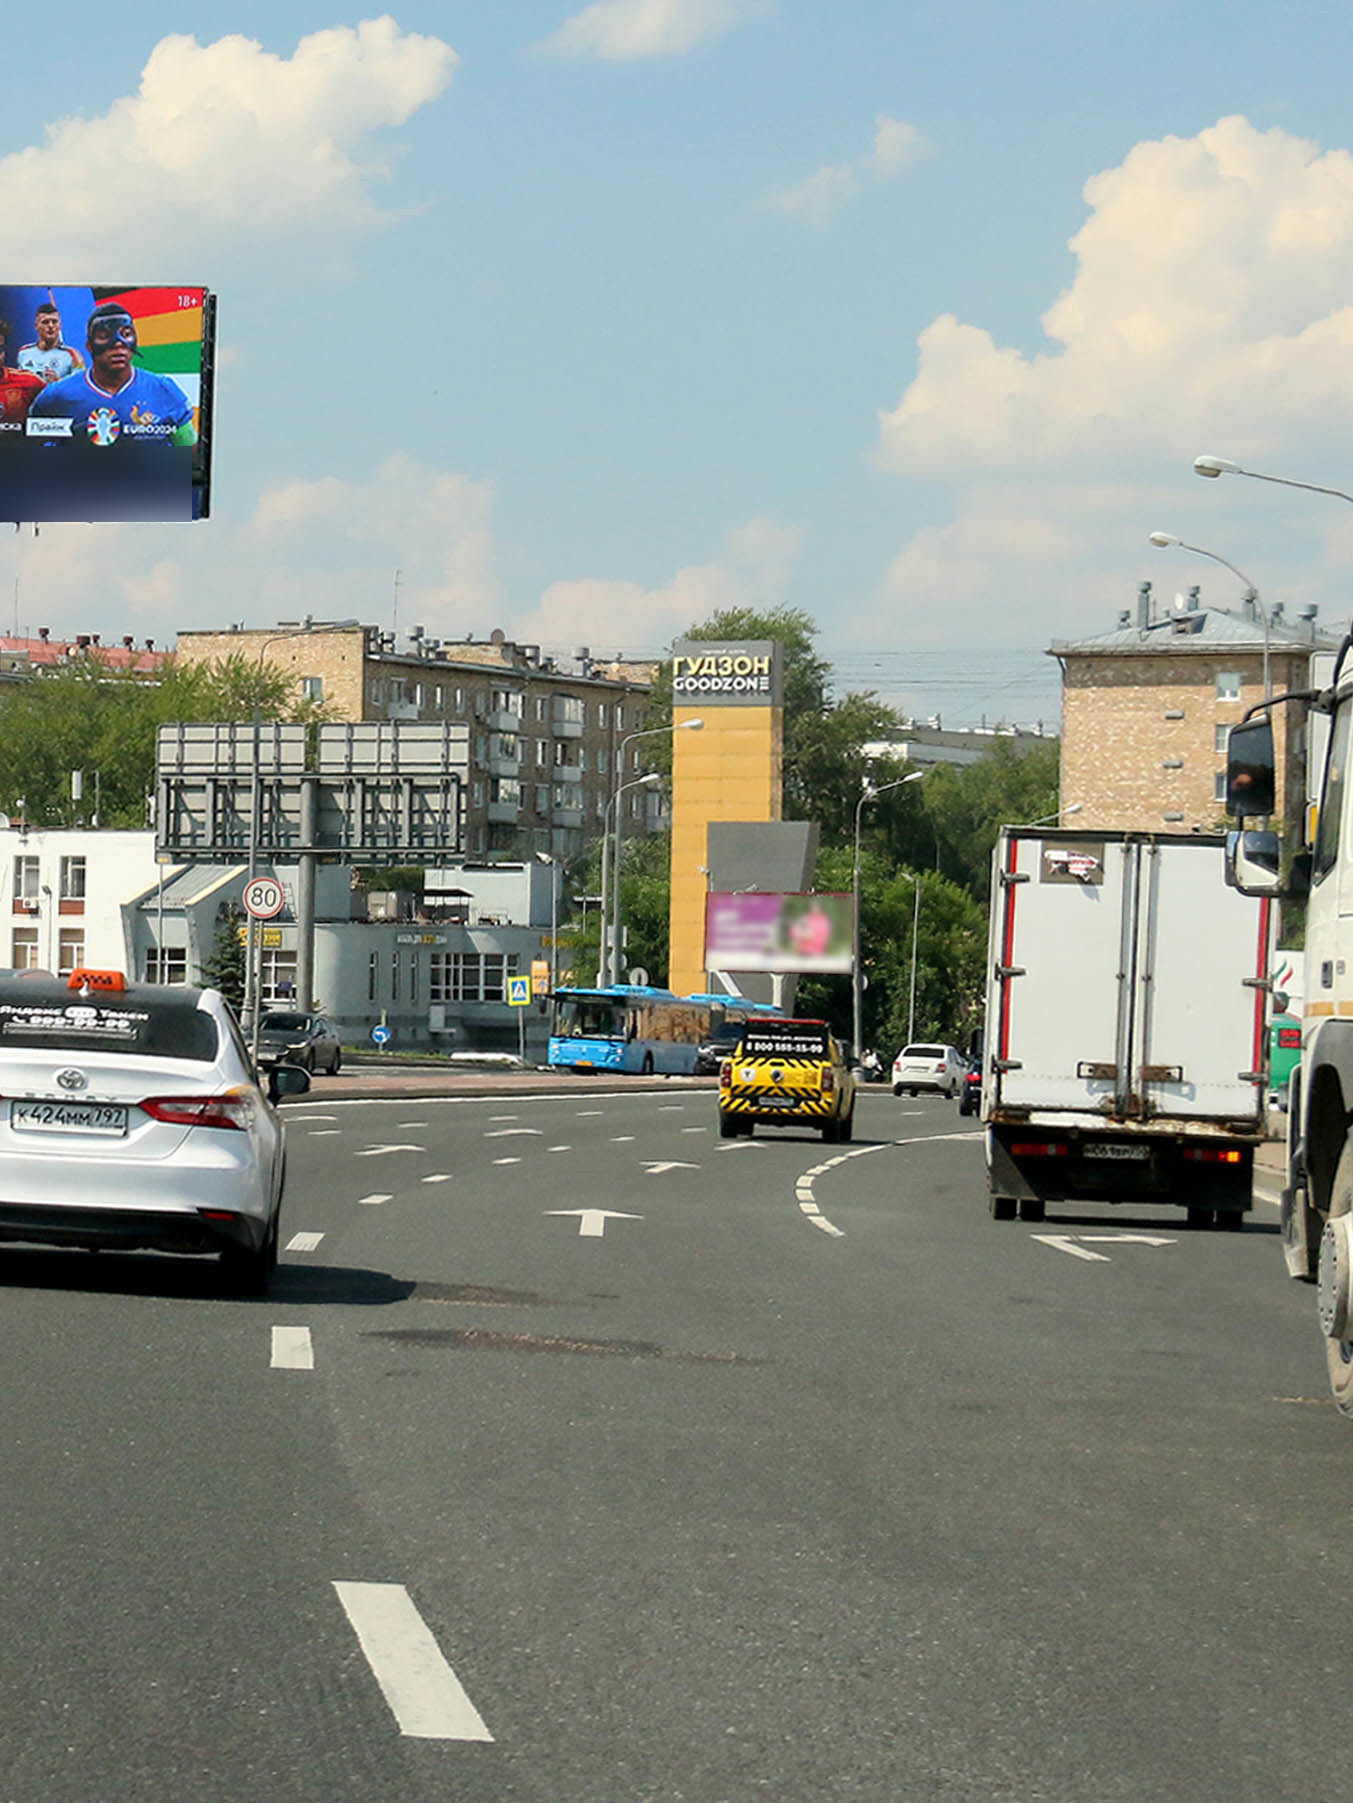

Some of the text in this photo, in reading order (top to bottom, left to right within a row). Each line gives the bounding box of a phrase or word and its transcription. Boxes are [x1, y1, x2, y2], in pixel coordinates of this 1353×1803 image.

[177, 295, 198, 307] 18+
[673, 655, 770, 676] ГУДЗОН
[673, 677, 770, 691] GOODZONE
[251, 887, 277, 908] 80
